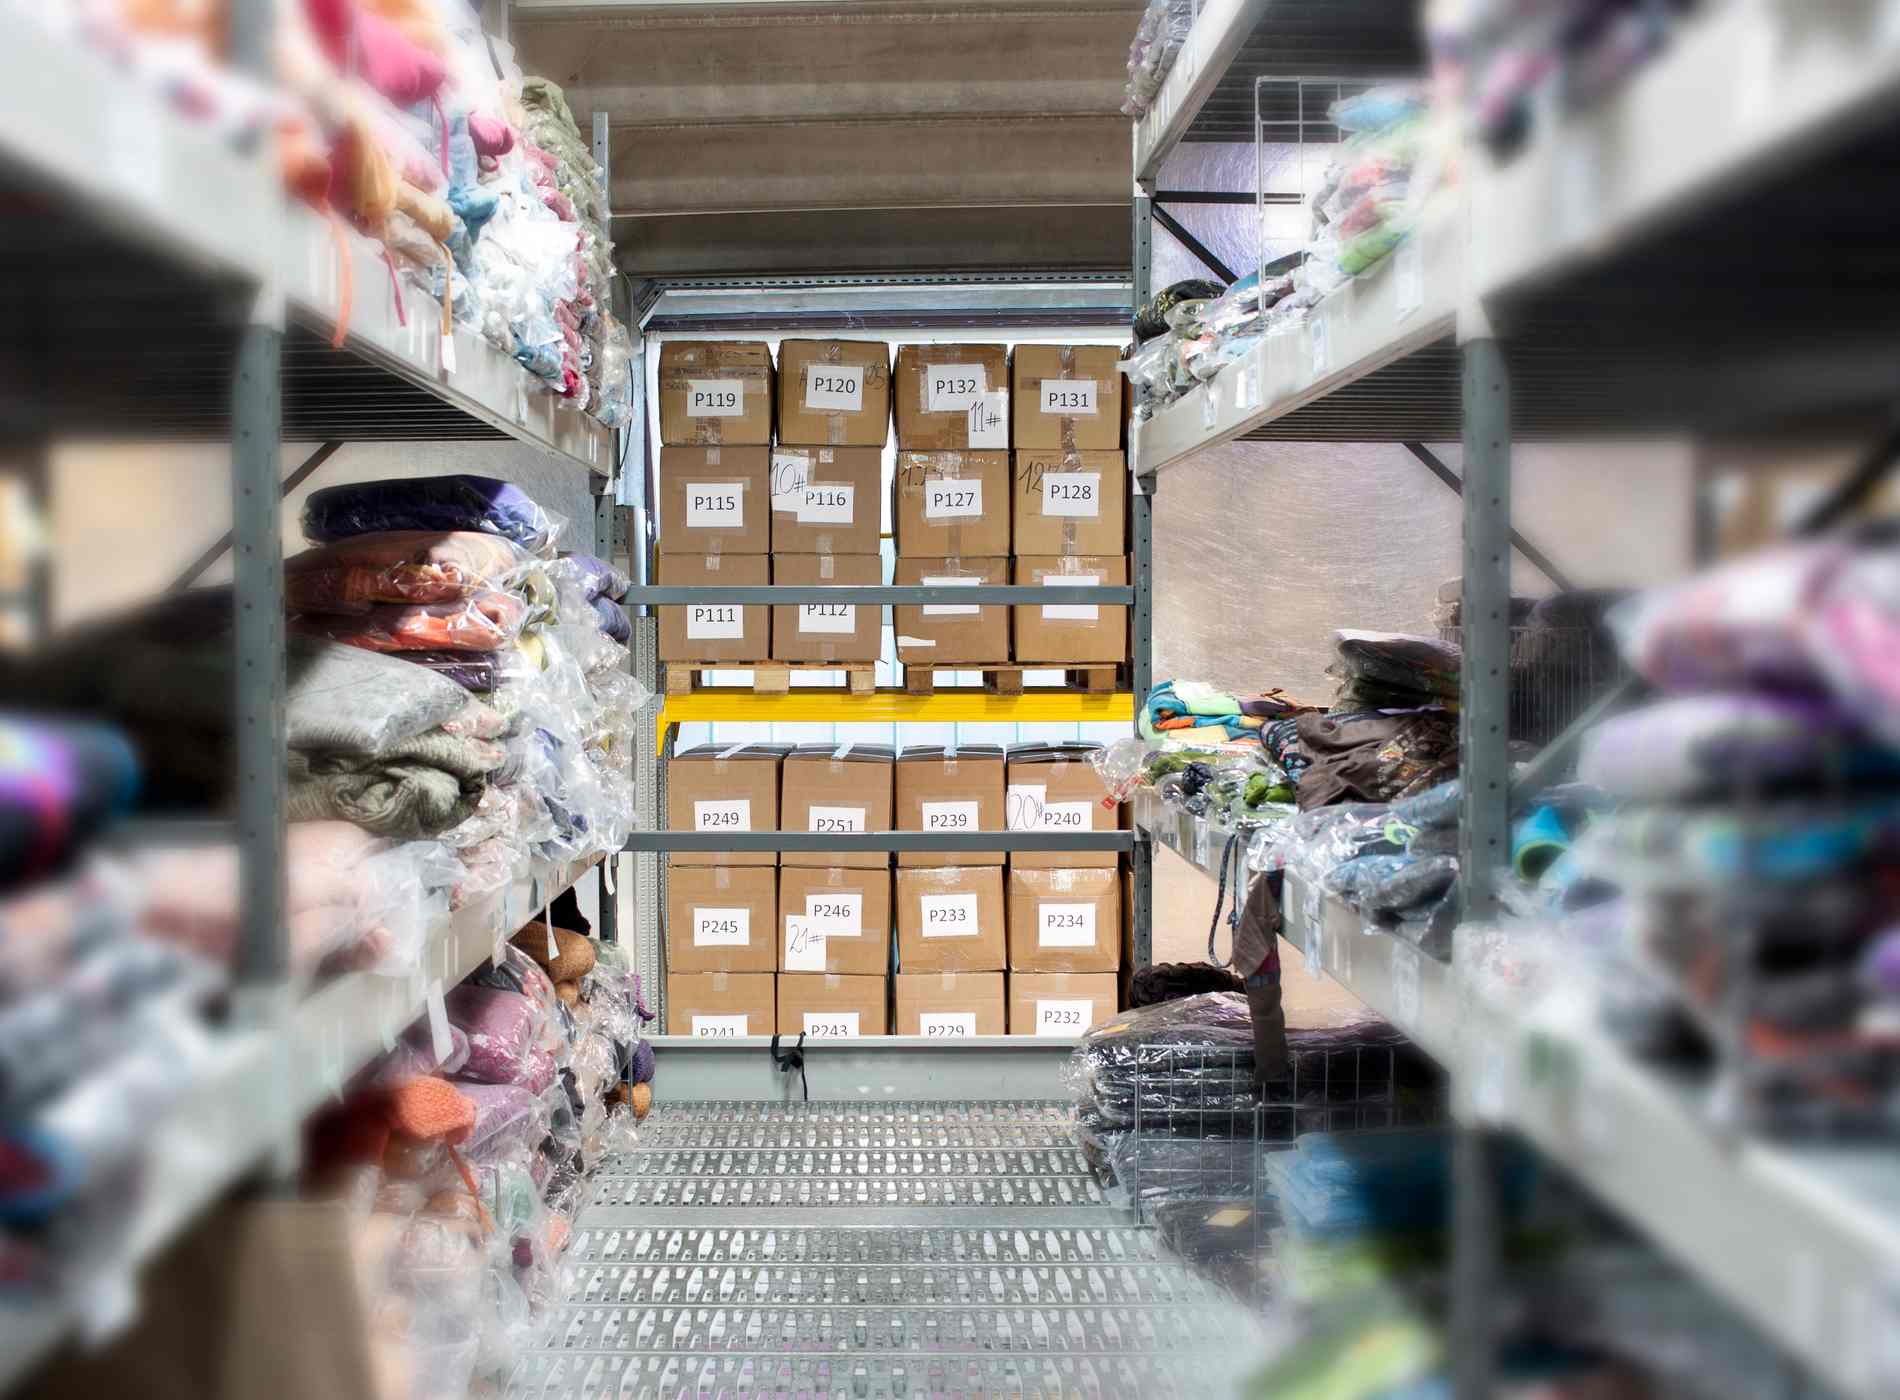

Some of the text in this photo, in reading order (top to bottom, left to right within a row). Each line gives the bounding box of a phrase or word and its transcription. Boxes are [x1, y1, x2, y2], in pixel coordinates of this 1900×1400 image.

[814, 377, 856, 394] P120
[936, 379, 977, 394] P132
[695, 392, 736, 407] P119
[1049, 392, 1089, 408] P131
[970, 401, 1001, 432] 11#
[771, 463, 806, 496] 10#
[805, 492, 846, 506] P116
[1051, 484, 1092, 500] P128
[695, 496, 735, 511] P115
[933, 492, 975, 507] P127
[695, 608, 735, 623] P111
[807, 603, 847, 617] P112
[703, 812, 739, 826] P249
[817, 818, 853, 831] P251
[930, 813, 967, 828] P239
[1044, 812, 1081, 825] P240
[814, 904, 850, 918] P246
[930, 908, 966, 922] P233
[702, 920, 738, 934] P245
[1047, 914, 1083, 928] P234
[1044, 1011, 1080, 1024] P232
[811, 1024, 848, 1036] P243
